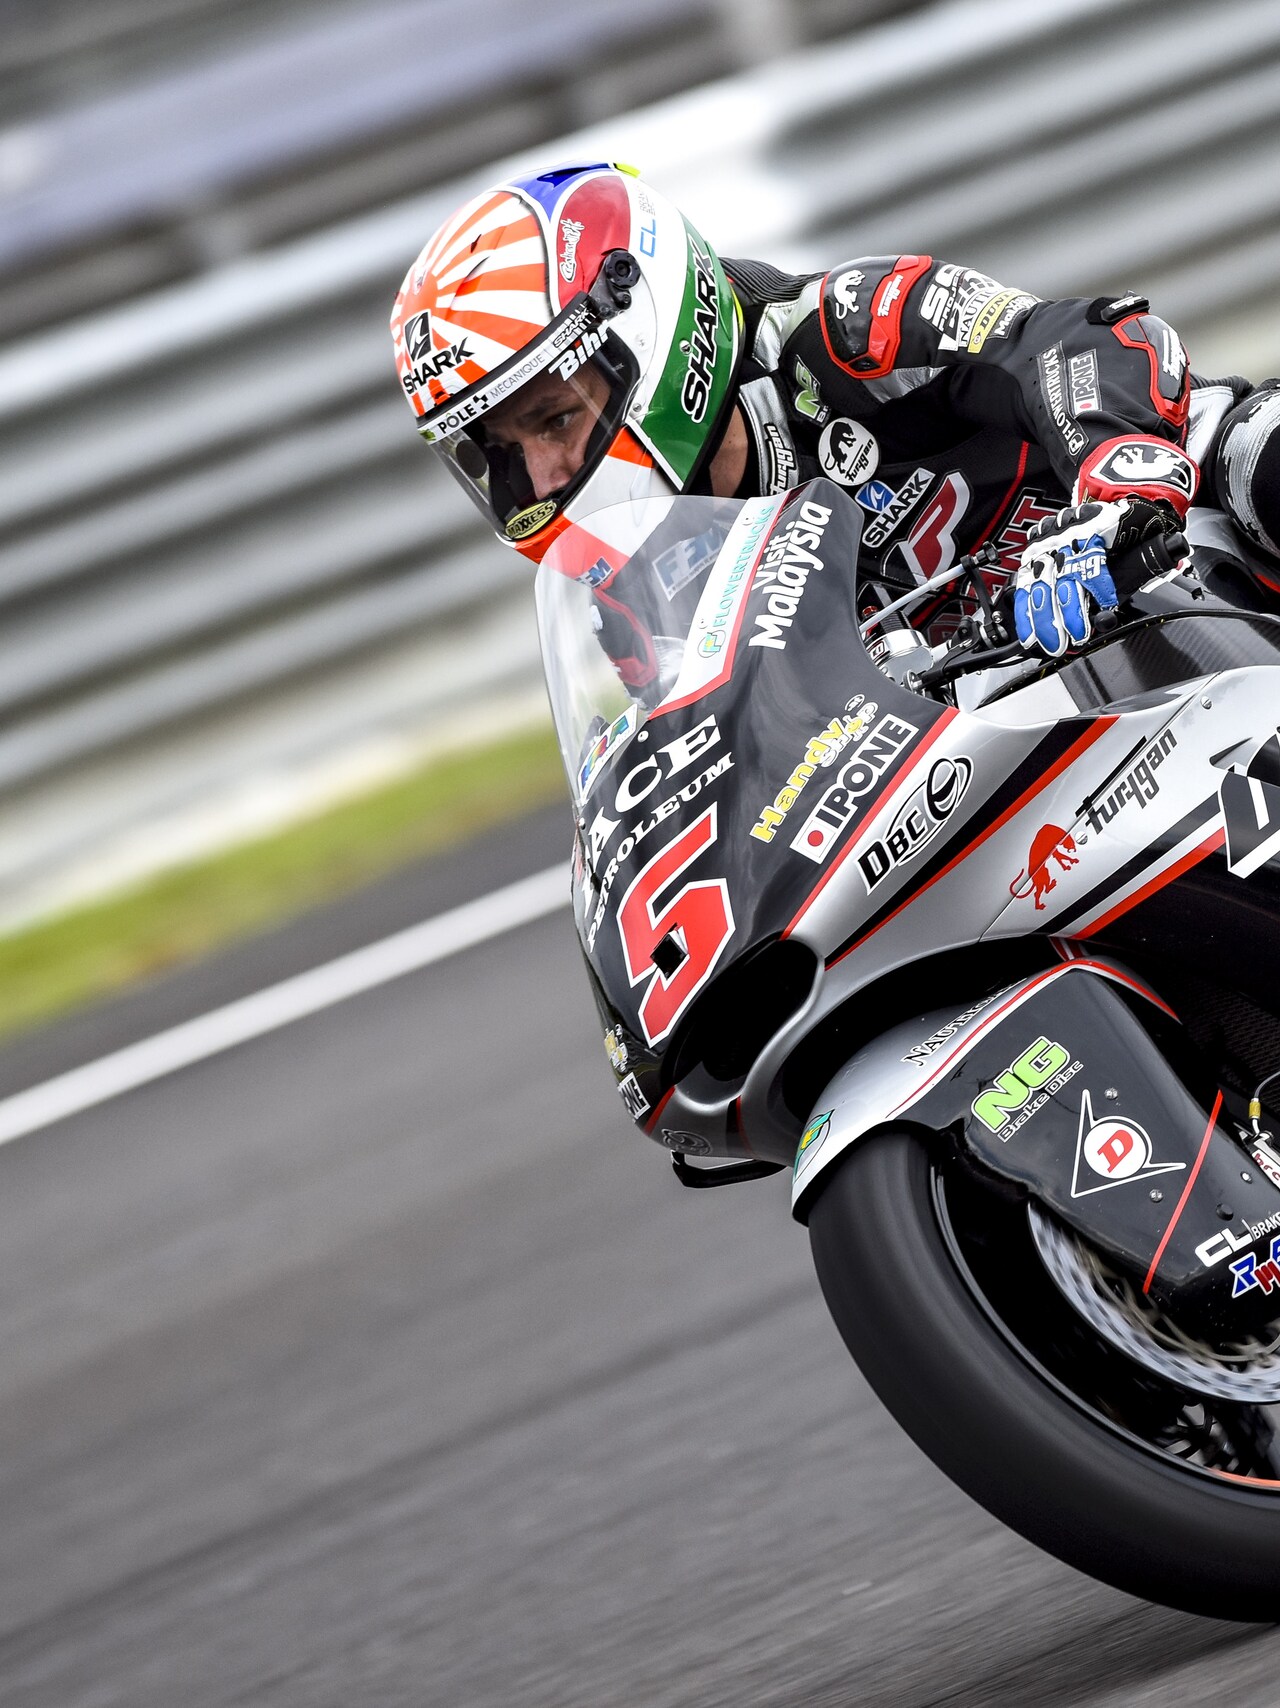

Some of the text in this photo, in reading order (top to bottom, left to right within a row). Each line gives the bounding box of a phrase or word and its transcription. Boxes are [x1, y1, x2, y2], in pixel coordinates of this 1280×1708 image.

[403, 336, 475, 394] SHARK
[548, 319, 609, 381] Bihr
[681, 233, 719, 423] SHARK
[437, 403, 477, 434] PÔLE
[1071, 354, 1096, 400] IPONE
[506, 500, 557, 538] MAXXESS
[864, 473, 931, 546] SHARK
[713, 504, 775, 628] FLOWERTRUCKS
[748, 500, 833, 650] Malaysia
[751, 531, 792, 592] Visit
[750, 717, 845, 843] Handy
[815, 717, 912, 830] IPONE
[587, 751, 736, 954] PETROLEUM
[616, 801, 737, 1049] 5
[971, 1036, 1071, 1134] NG
[998, 1060, 1085, 1143] Brake Disc
[1195, 1219, 1253, 1268] CL
